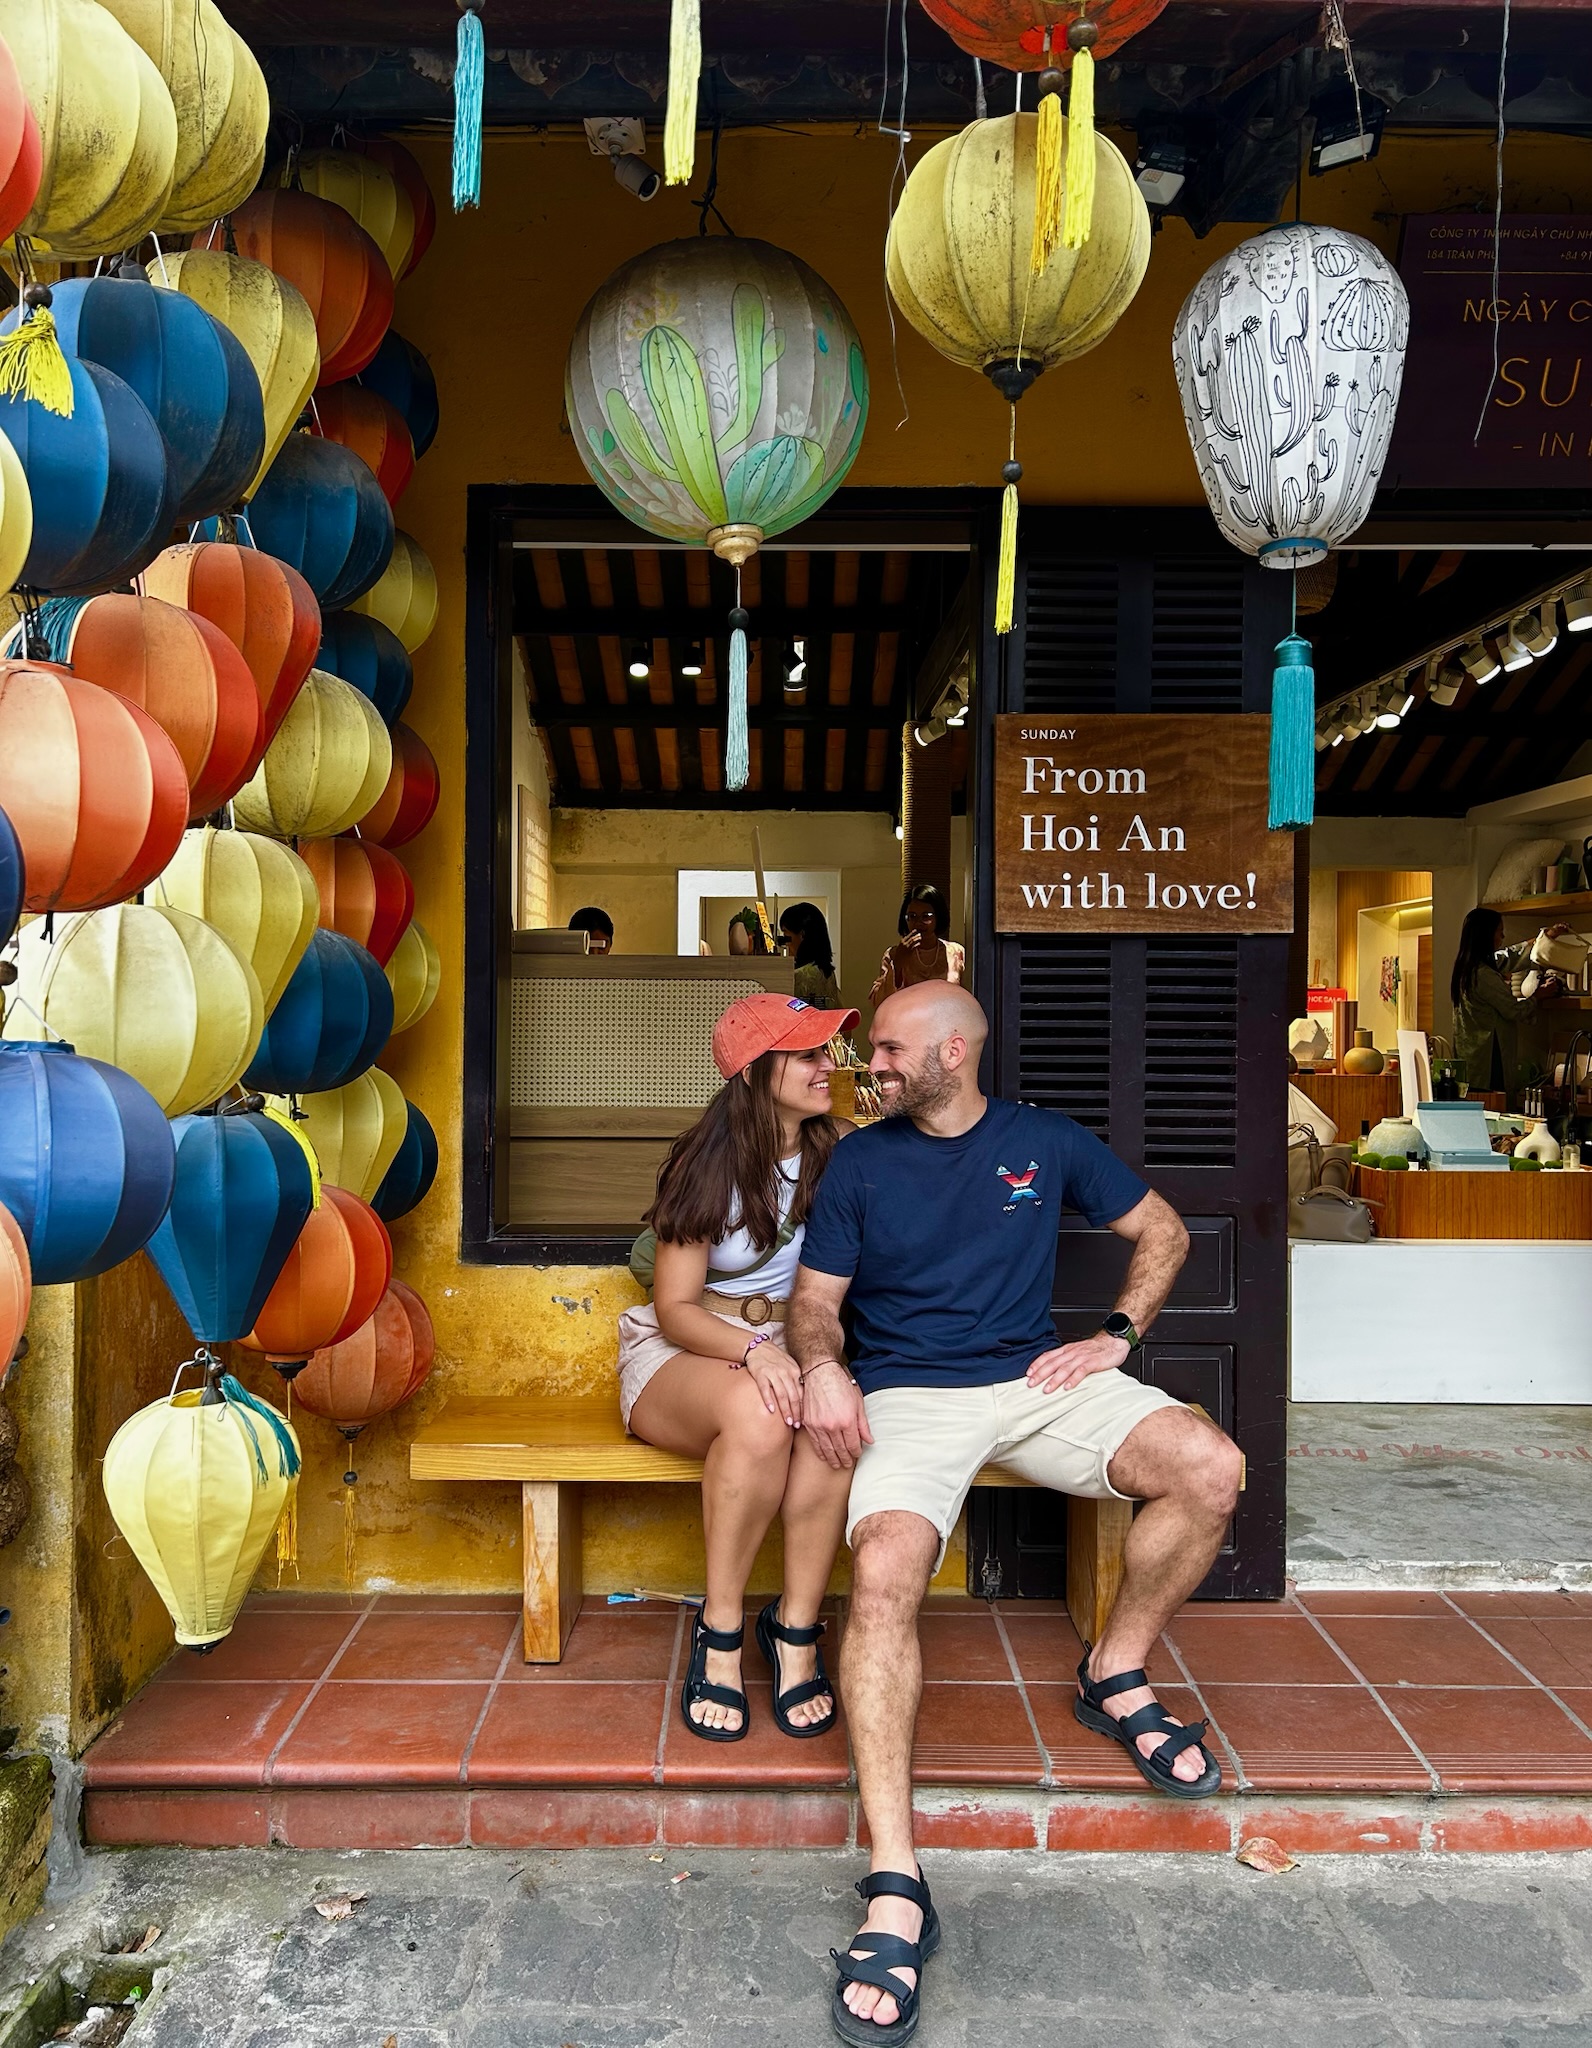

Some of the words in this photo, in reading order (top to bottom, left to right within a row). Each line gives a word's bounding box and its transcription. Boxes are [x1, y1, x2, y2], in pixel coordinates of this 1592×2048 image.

[1467, 228, 1481, 239] TY
[1427, 249, 1444, 260] 184
[1560, 250, 1578, 261] +84
[1463, 292, 1559, 323] NGÀY
[1495, 356, 1592, 408] SU
[1538, 431, 1576, 457] IN
[1020, 728, 1077, 741] SUNDAY
[1020, 756, 1148, 795] From
[1019, 814, 1102, 852] Hoi
[1116, 814, 1187, 852] An
[1019, 872, 1128, 910] with
[1144, 872, 1258, 910] love!
